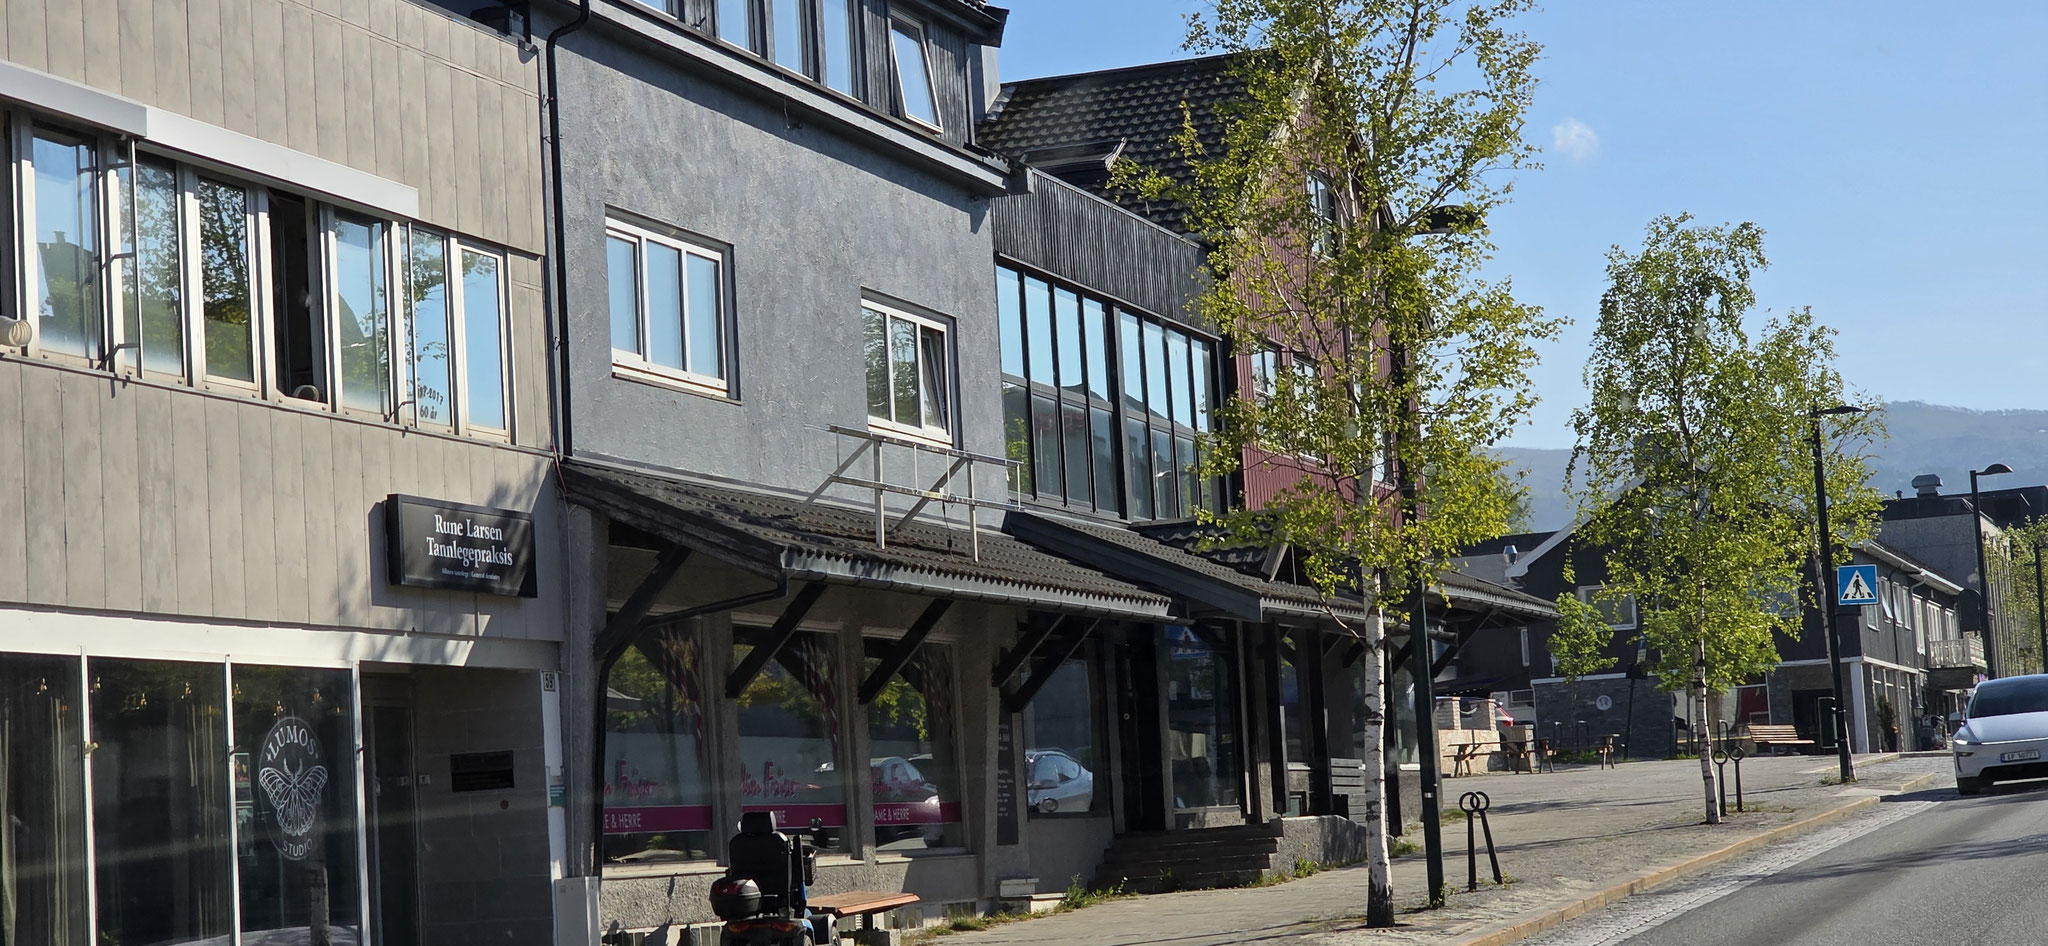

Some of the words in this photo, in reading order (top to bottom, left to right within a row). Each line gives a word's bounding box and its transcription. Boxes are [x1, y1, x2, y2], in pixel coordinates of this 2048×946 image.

[419, 404, 429, 418] 60
[430, 405, 438, 420] år
[434, 514, 464, 536] Rune
[466, 518, 503, 541] Larsen
[426, 536, 513, 568] Tannlegepraksis
[545, 673, 554, 689] 59
[268, 725, 316, 759] LUMOS
[611, 814, 617, 829] &
[618, 813, 642, 829] HERRE
[874, 808, 887, 821] AME
[888, 808, 892, 821] &
[893, 808, 910, 821] HERRE
[282, 838, 313, 857] STUDIO
